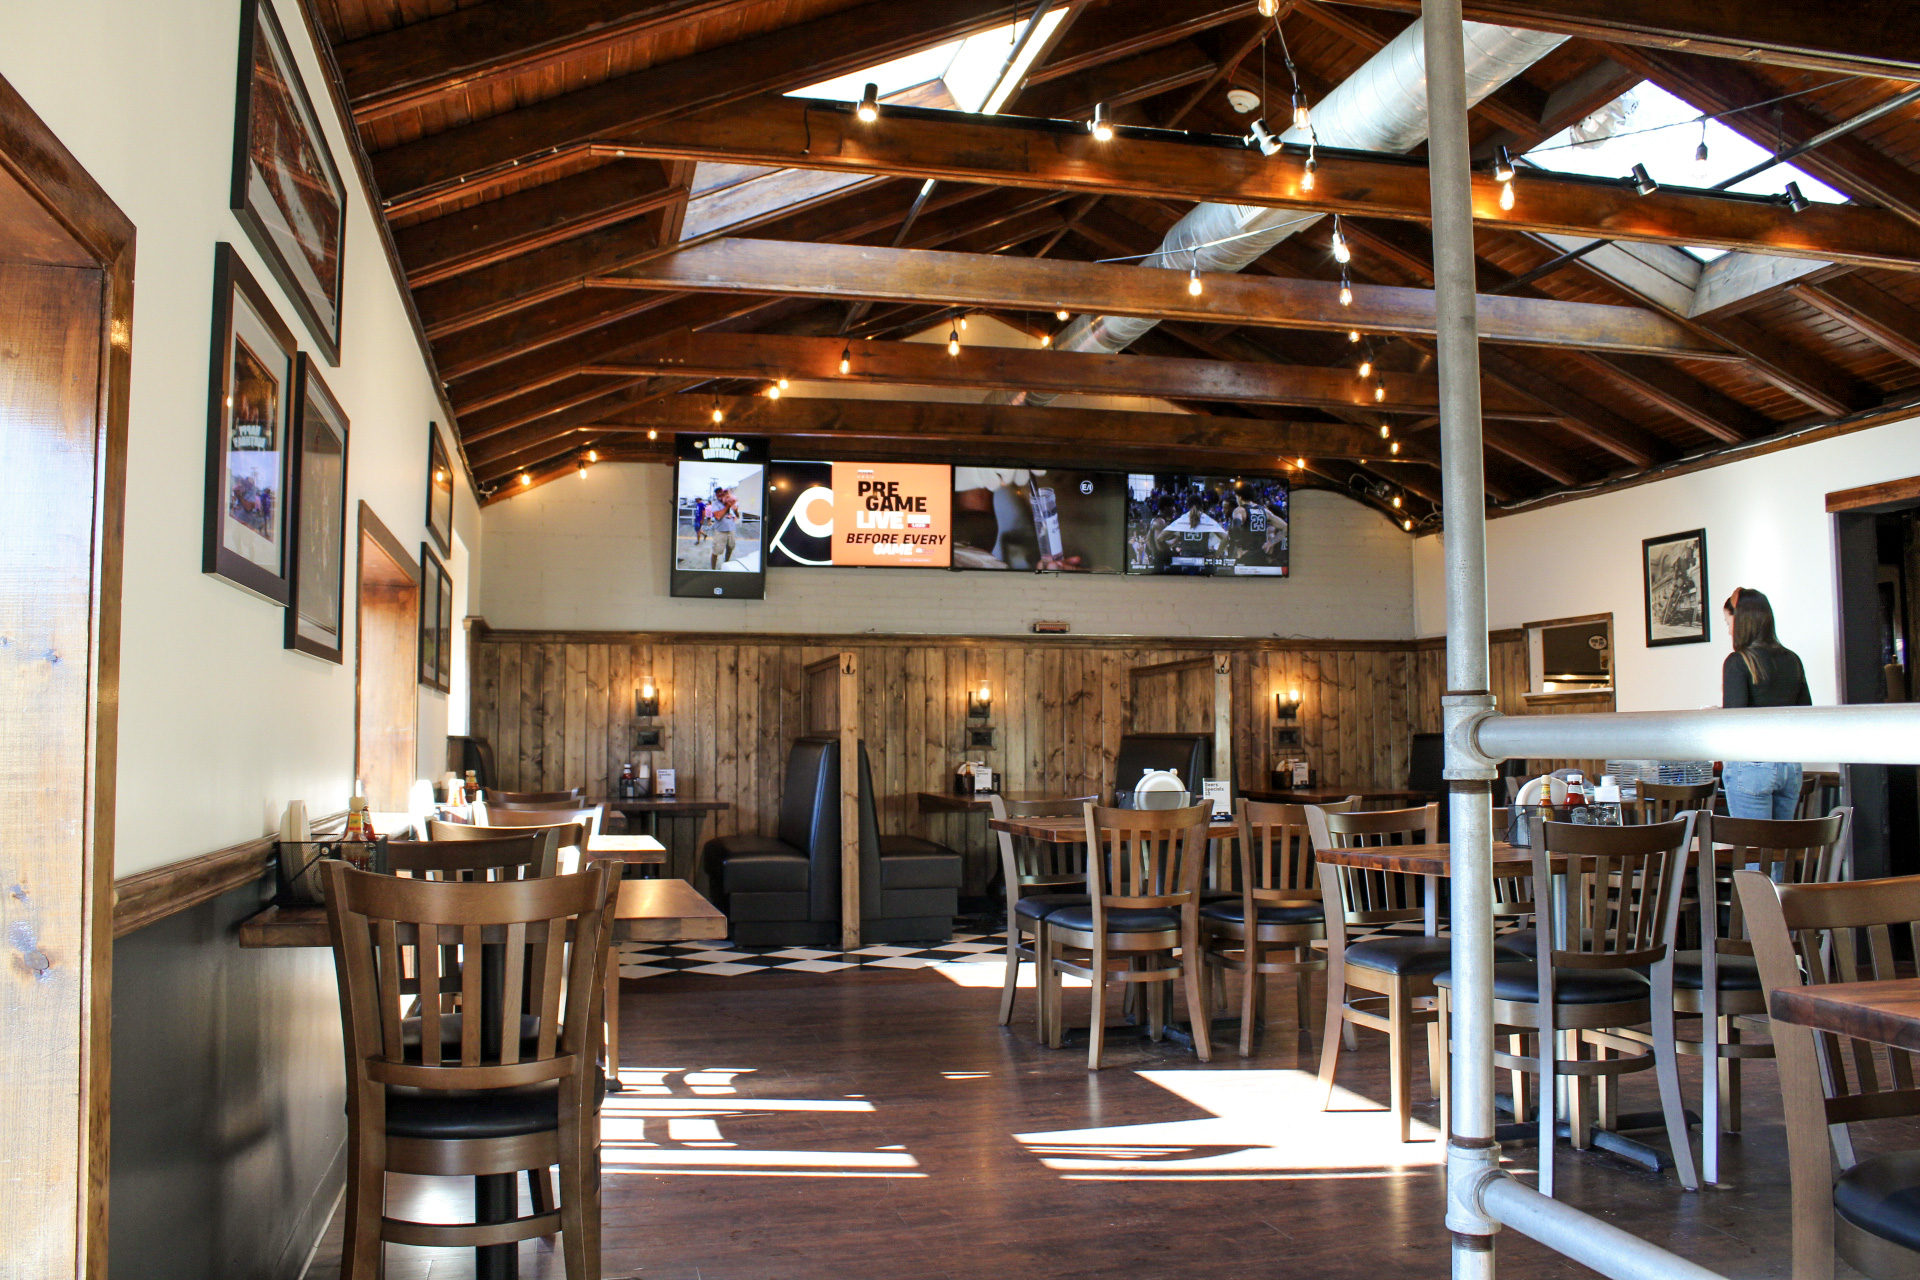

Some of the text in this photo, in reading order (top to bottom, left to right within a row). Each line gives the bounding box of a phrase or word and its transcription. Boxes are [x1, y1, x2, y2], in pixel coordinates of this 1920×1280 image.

[708, 437, 735, 449] HAPPY
[702, 448, 740, 461] BIRTHDAY
[858, 480, 899, 498] PRE
[866, 495, 927, 512] GAME
[857, 510, 904, 529] LIVE
[1250, 514, 1266, 532] 23
[846, 533, 946, 545] BEFORE EVERY
[873, 543, 914, 555] GAME
